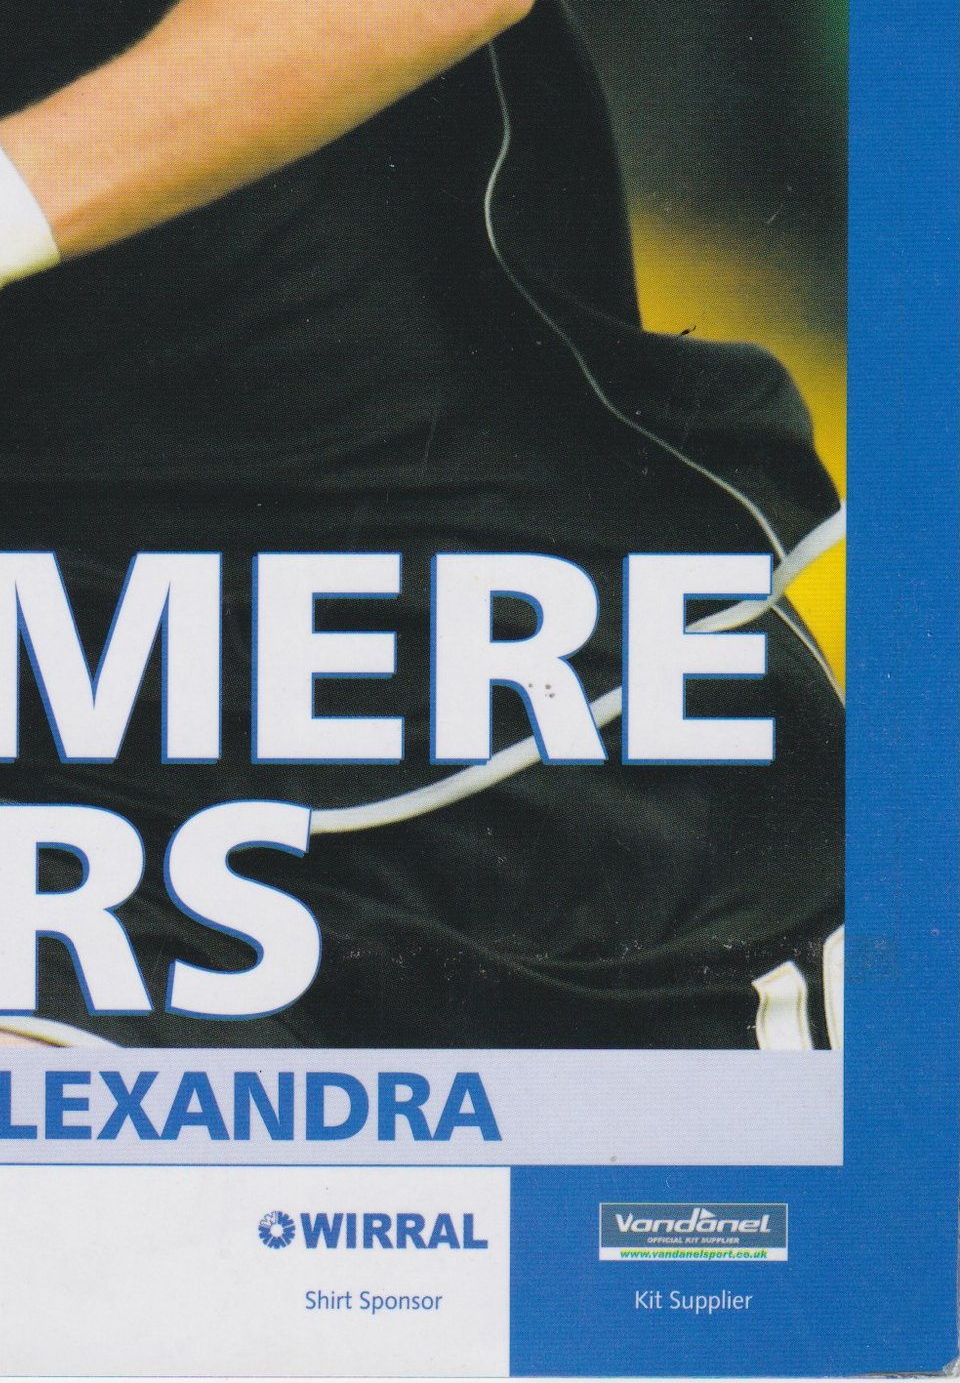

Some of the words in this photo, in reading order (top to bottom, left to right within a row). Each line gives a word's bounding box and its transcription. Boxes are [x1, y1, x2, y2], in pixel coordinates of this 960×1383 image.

[300, 1212, 489, 1250] WIRRAL
[615, 1207, 771, 1233] Vandanel
[620, 1249, 768, 1260] www.vandanelsport.co.uk
[305, 1289, 353, 1310] Shirt
[359, 1290, 443, 1315] Sponsor
[635, 1290, 663, 1310] Kit
[669, 1289, 753, 1315] Supplier
